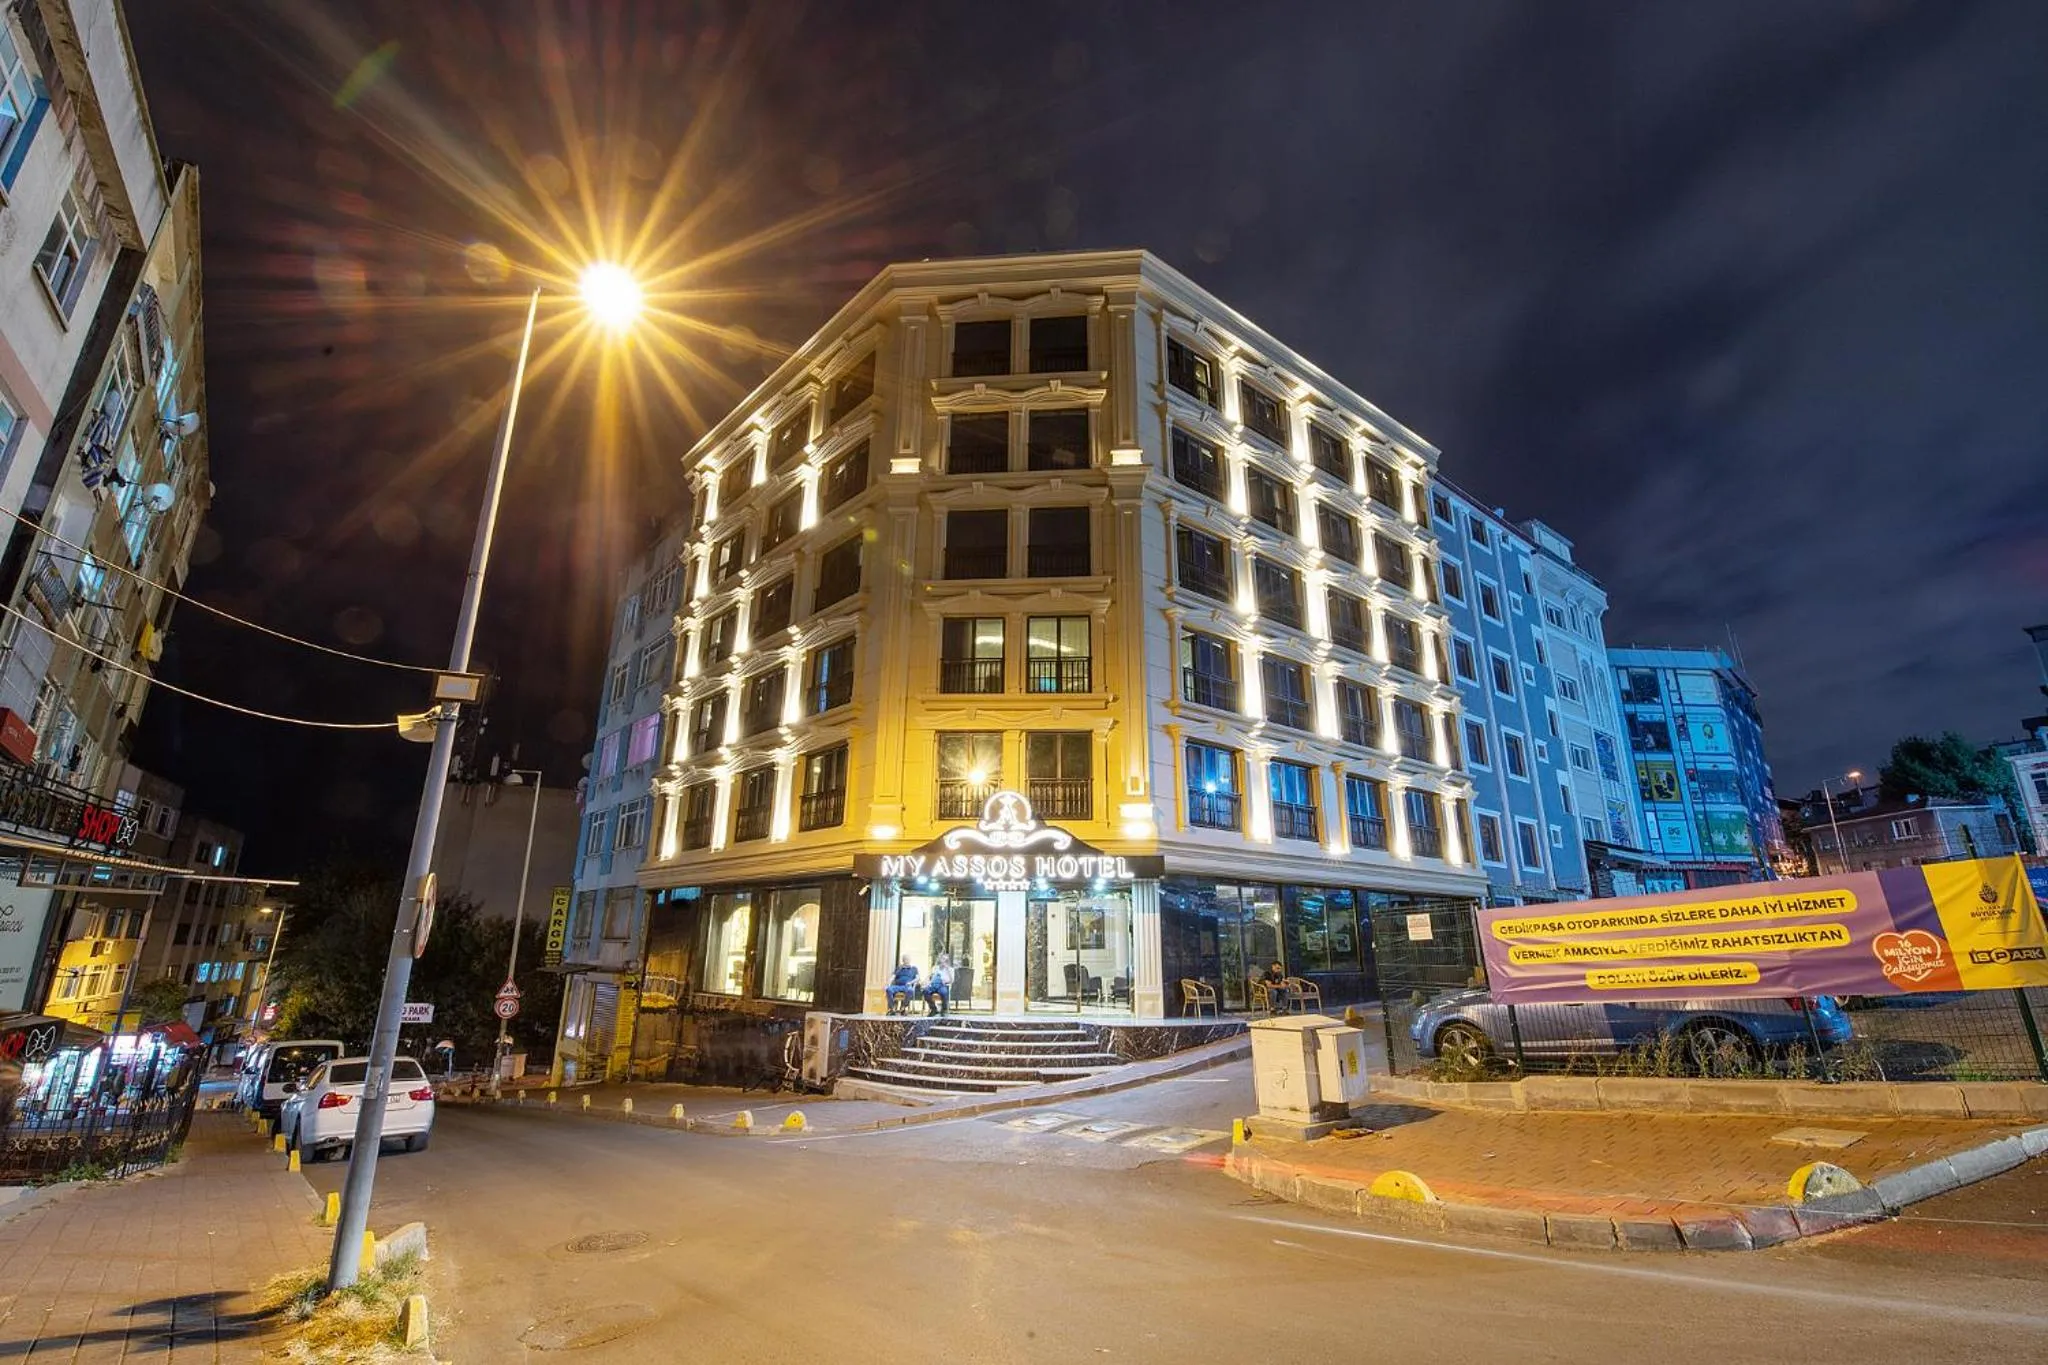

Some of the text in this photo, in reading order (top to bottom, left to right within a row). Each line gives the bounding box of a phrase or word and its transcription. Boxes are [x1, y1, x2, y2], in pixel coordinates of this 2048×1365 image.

[79, 804, 119, 845] SHOP
[881, 855, 1134, 878] MY ASSOS HOTEL
[550, 897, 567, 949] CARGO
[1500, 897, 1846, 936] GEDİKPAŞA OTOPARKINDA SİZLERE DAHA İYİ HİZMET
[1563, 945, 1628, 957] AMACIYLA
[1630, 938, 1710, 954] VERDİĞİMİZ
[1712, 929, 1843, 949] RAHATSIZLIKTAN
[502, 1003, 514, 1013] 20
